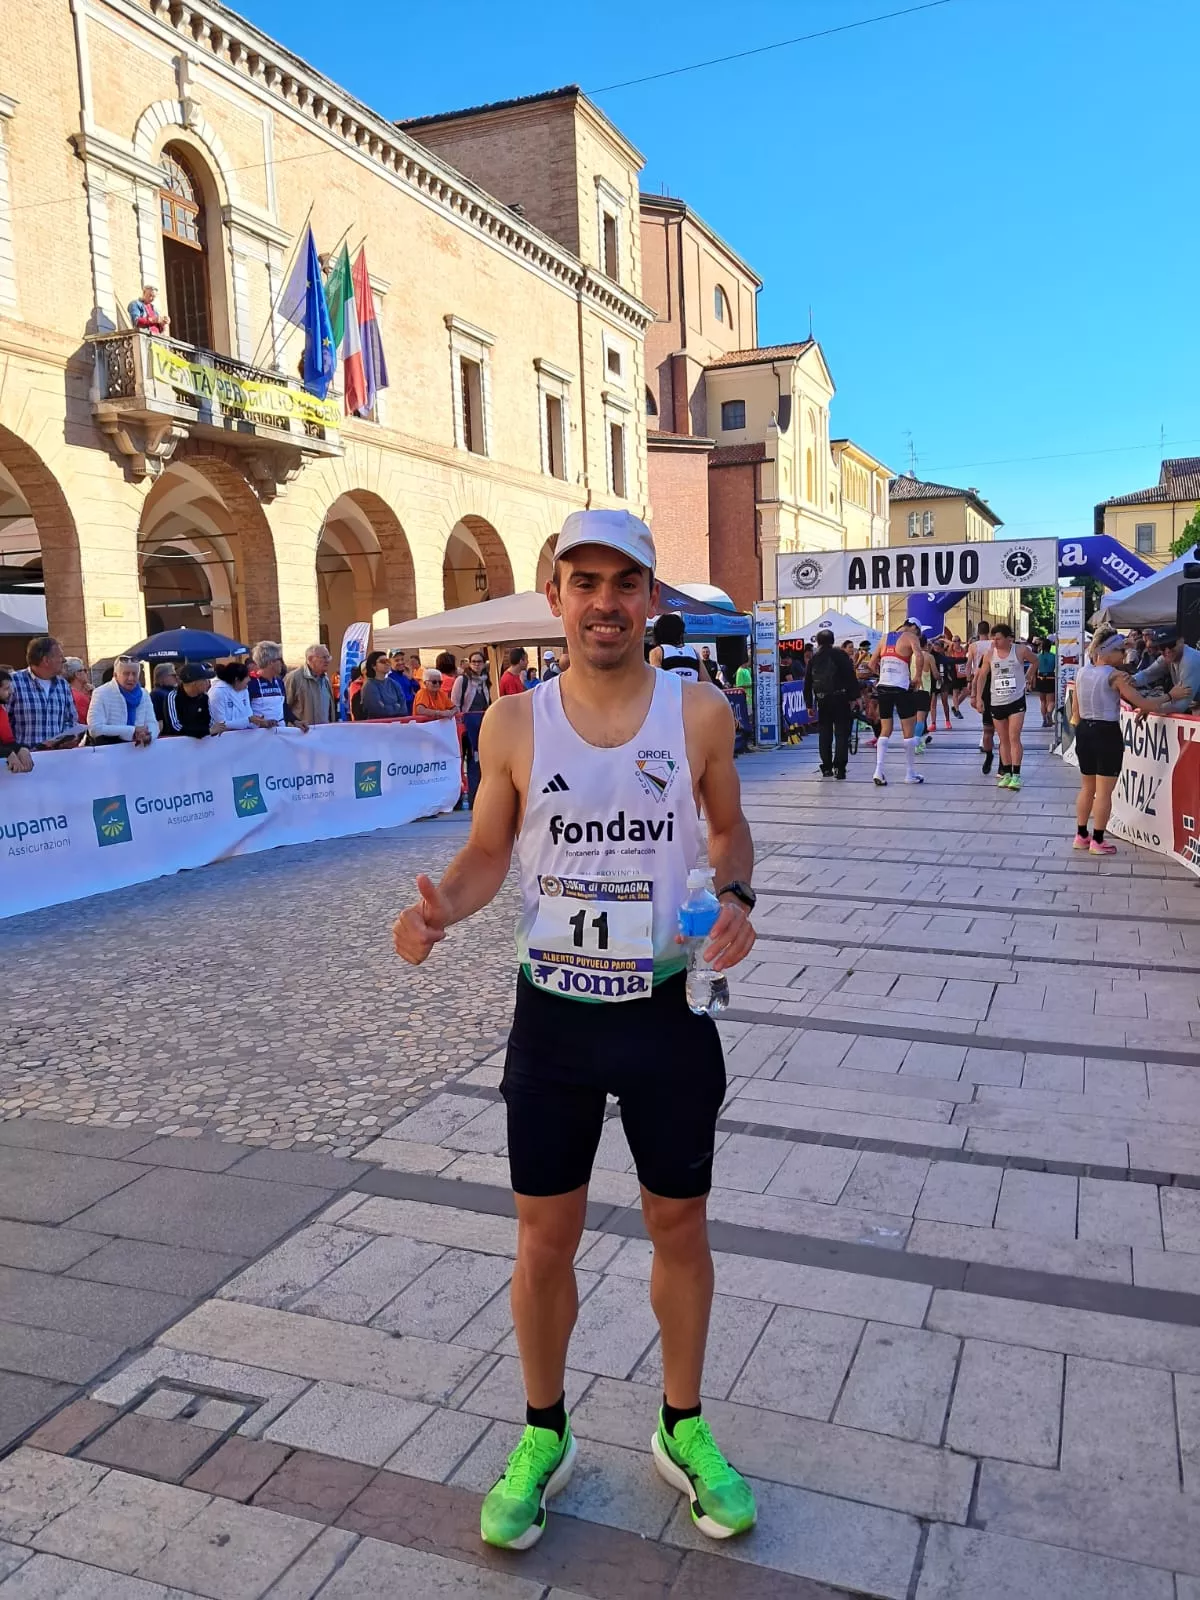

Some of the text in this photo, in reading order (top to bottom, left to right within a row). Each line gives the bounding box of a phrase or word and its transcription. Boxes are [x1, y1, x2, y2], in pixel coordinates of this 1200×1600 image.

[217, 378, 243, 404] PER
[848, 549, 979, 590] ARRIVO
[787, 690, 806, 718] Jom
[1121, 714, 1169, 764] AGNA
[637, 750, 673, 760] OROEL
[386, 760, 447, 777] Groupama
[265, 772, 335, 791] Groupama
[135, 790, 214, 815] Groupama
[167, 809, 215, 826] Assicurazioni
[549, 811, 675, 845] fondavi
[8, 837, 71, 858] Assicurazioni
[588, 881, 598, 892] di
[600, 881, 650, 894] ROMAGNA
[568, 909, 609, 950] 11
[542, 952, 574, 964] ALBERTO
[576, 957, 609, 969] PUYUELO
[557, 969, 649, 997] Joma
